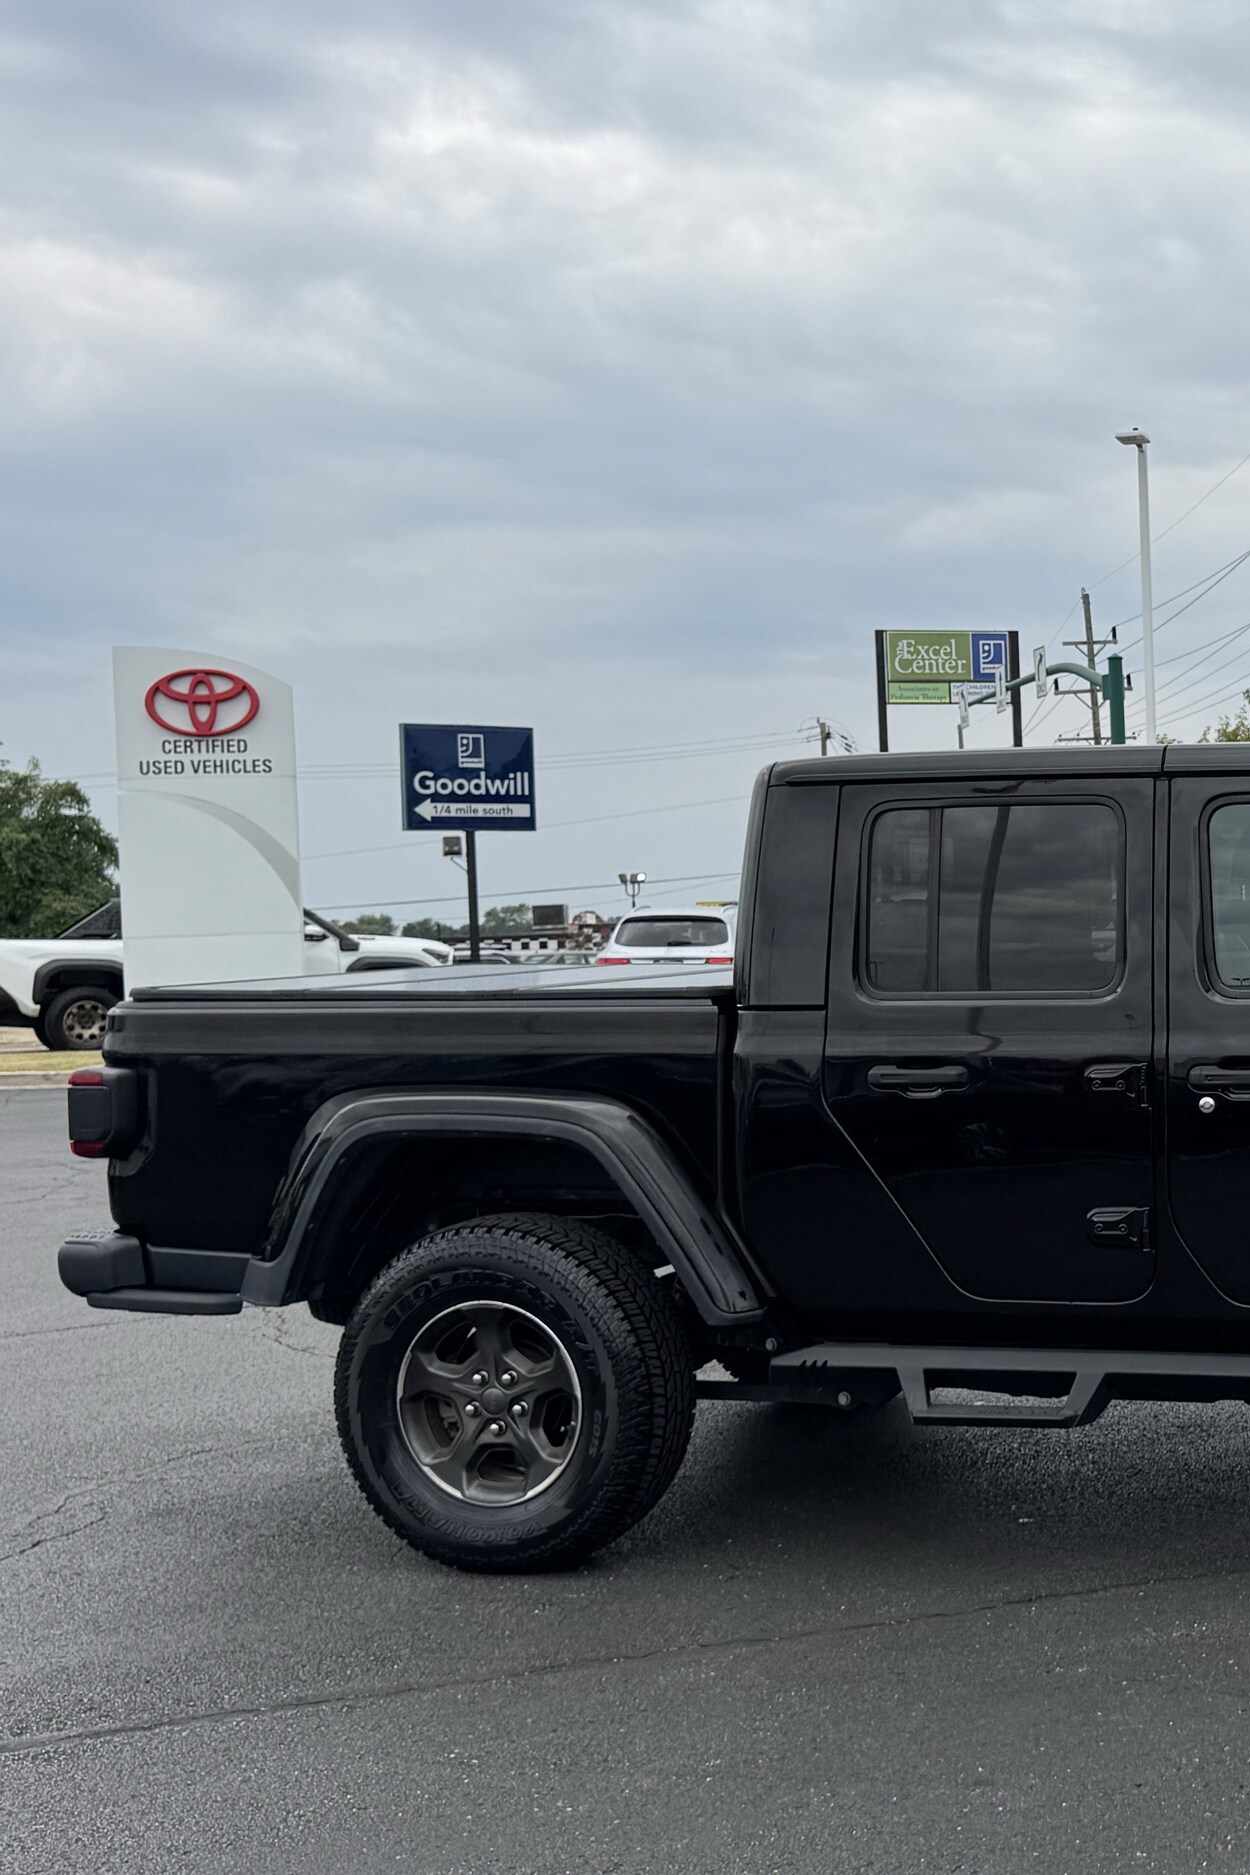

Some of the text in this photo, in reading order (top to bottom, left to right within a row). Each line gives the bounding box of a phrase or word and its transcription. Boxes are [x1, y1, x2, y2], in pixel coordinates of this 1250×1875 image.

[902, 639, 957, 660] Excel
[894, 654, 967, 675] Center
[161, 738, 249, 755] CERTIFIED
[138, 758, 273, 776] USED VEHICLES
[412, 770, 530, 797] Goodwill
[432, 803, 514, 817] 1/4 mile south
